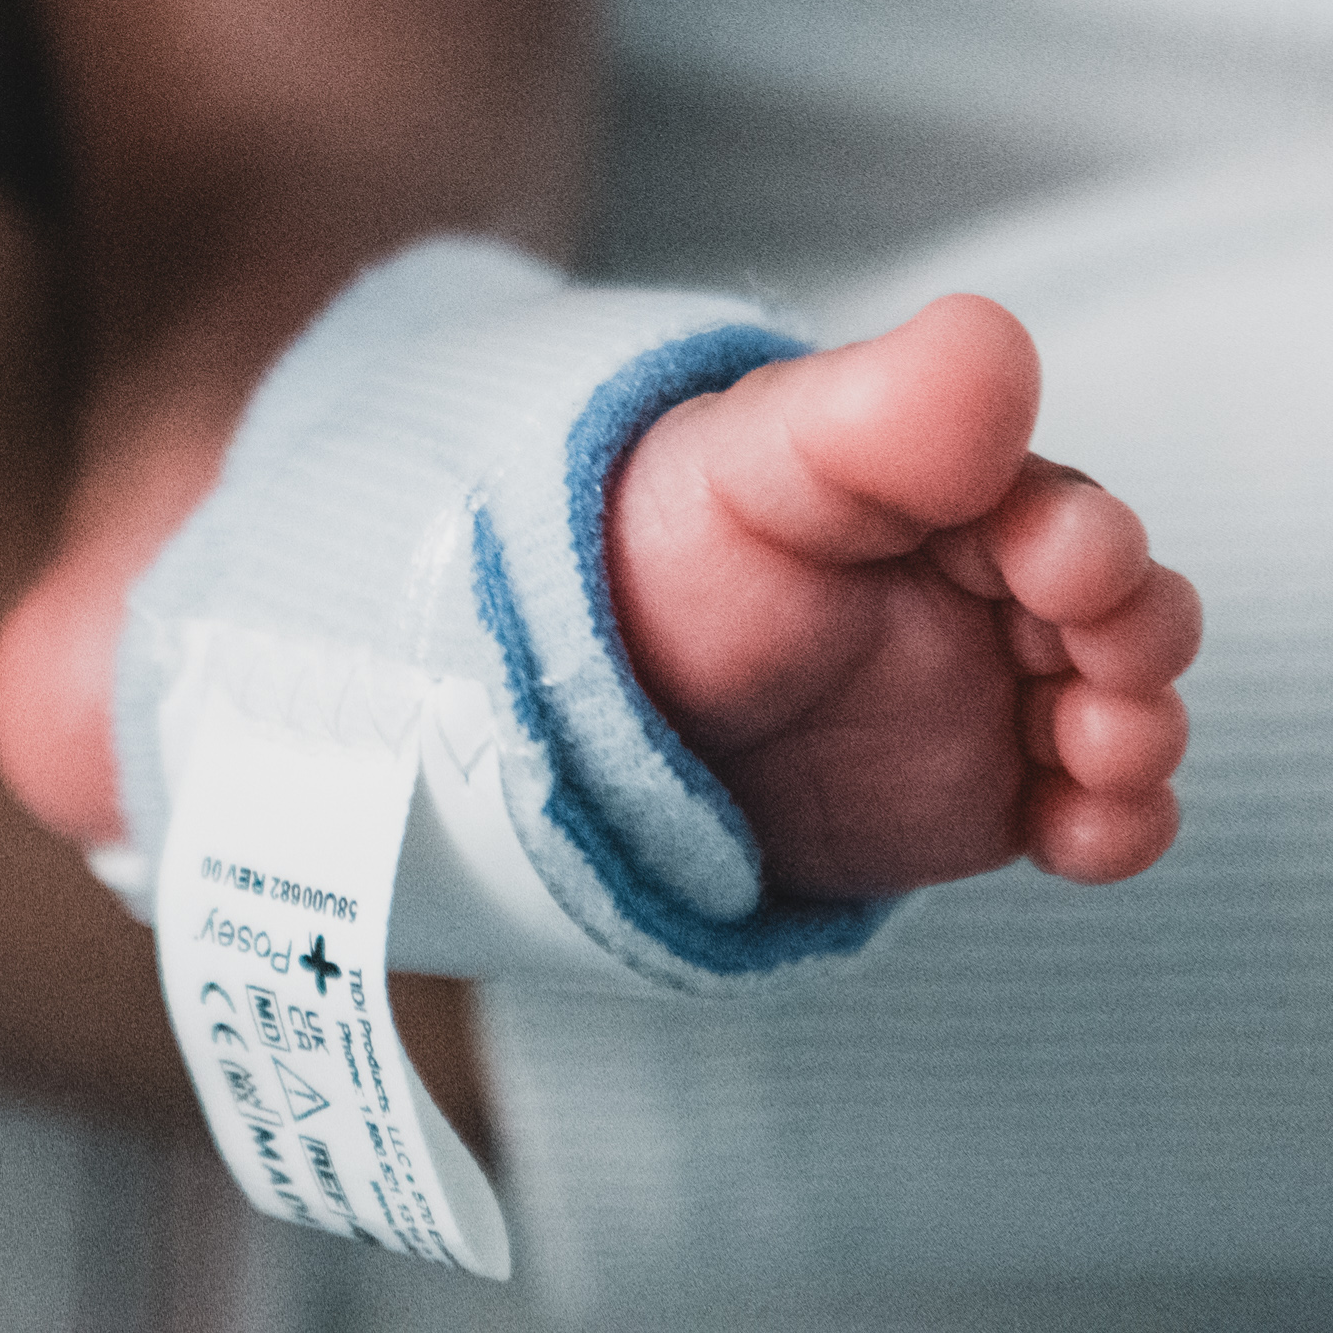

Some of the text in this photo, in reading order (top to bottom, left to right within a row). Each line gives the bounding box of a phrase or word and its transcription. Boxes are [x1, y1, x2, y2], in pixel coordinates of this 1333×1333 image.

[201, 856, 222, 883] 00
[224, 863, 265, 895] REV
[200, 907, 292, 974] Posey
[349, 968, 367, 1013] TIDI
[254, 994, 281, 1043] MD
[306, 1143, 347, 1209] REF
